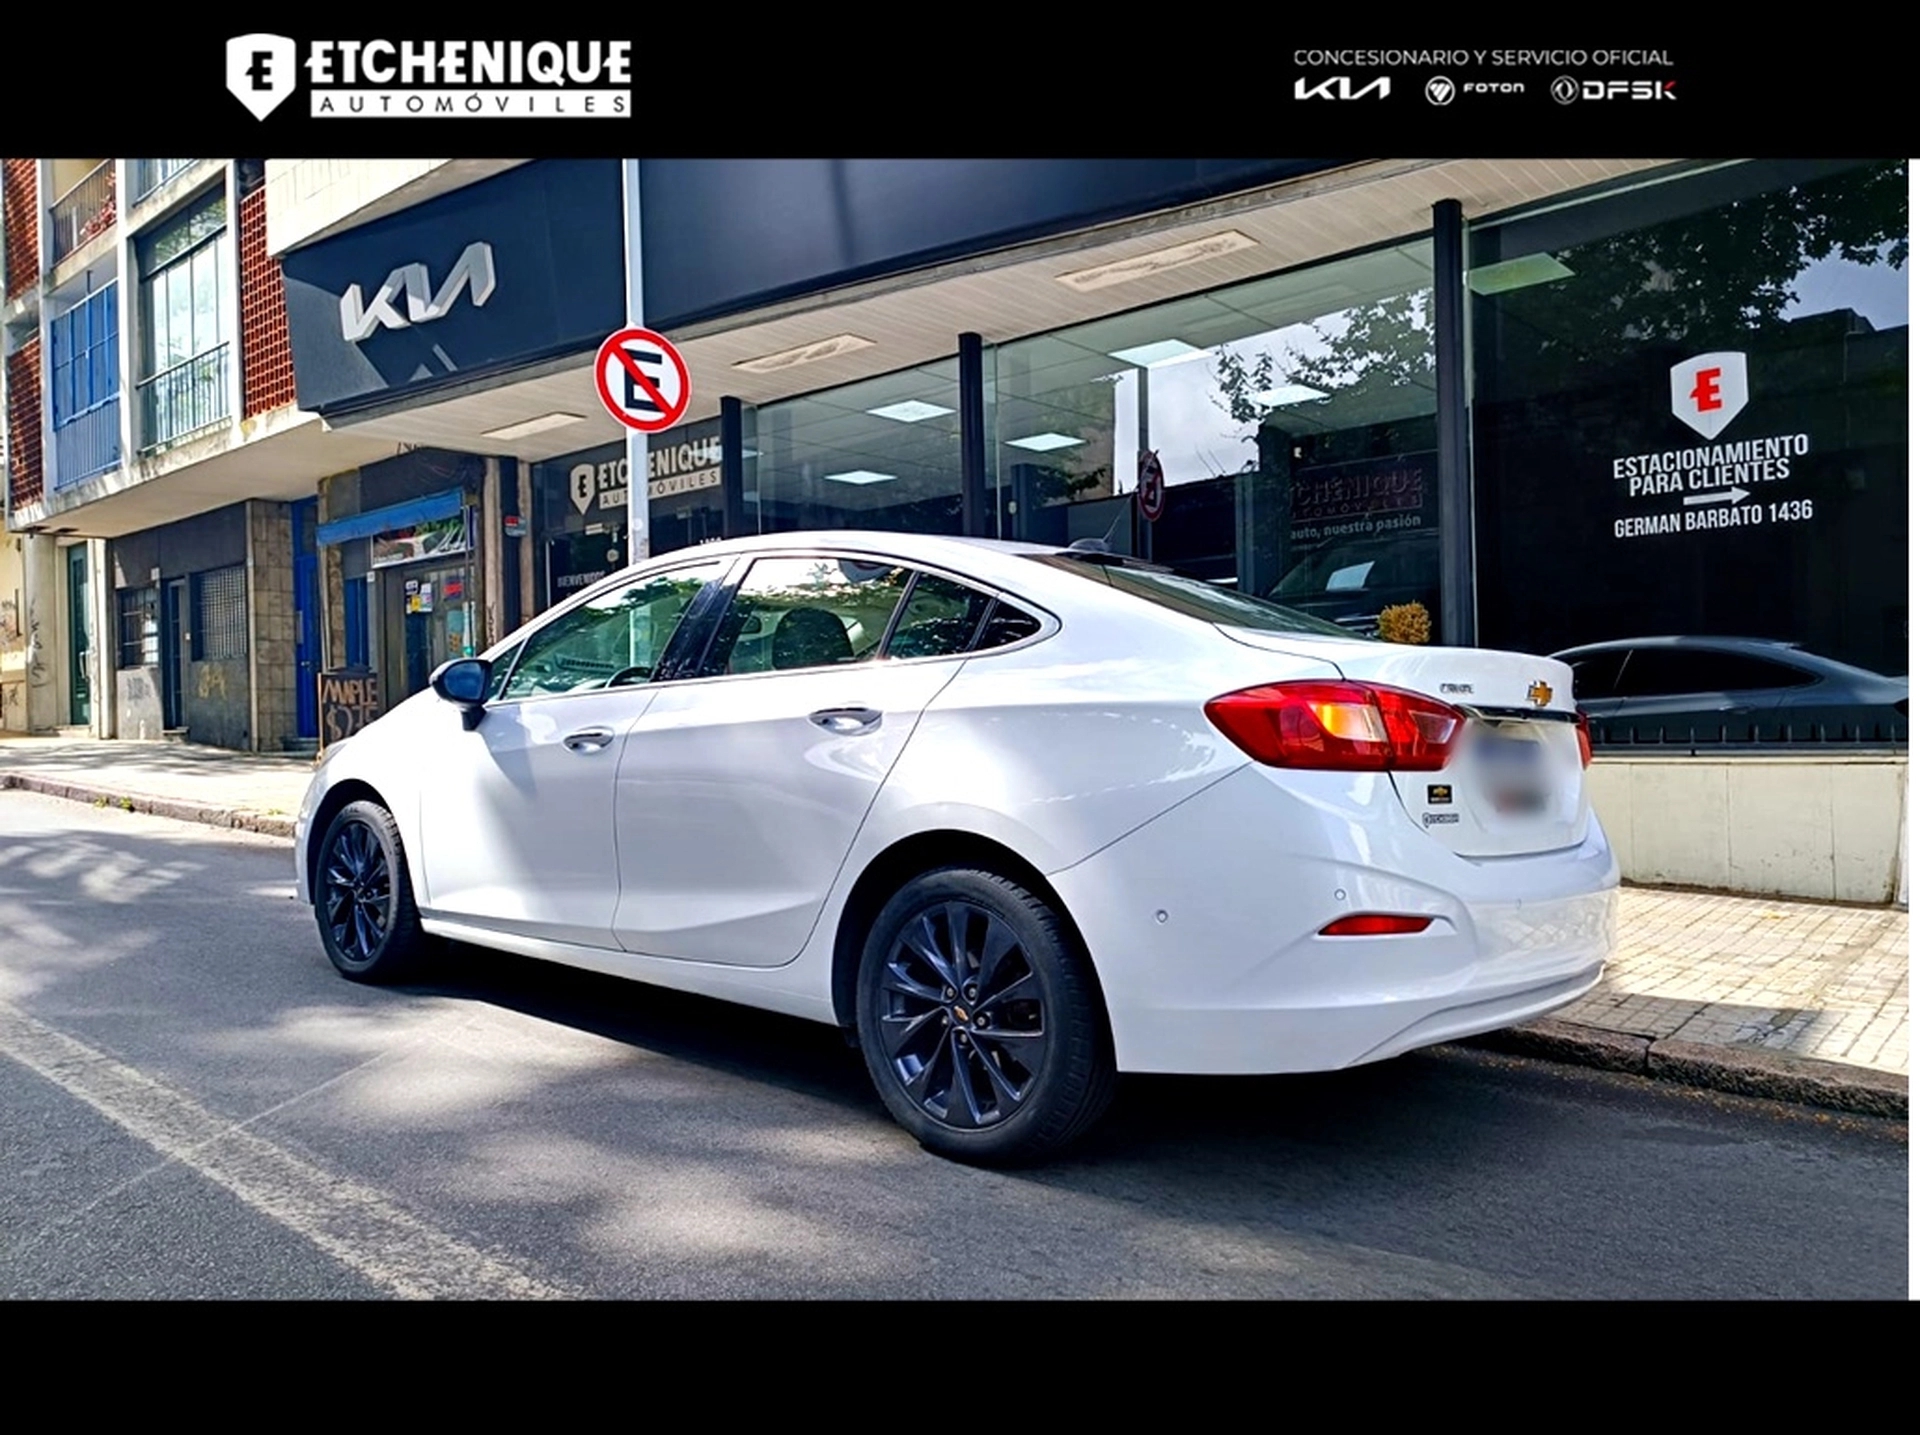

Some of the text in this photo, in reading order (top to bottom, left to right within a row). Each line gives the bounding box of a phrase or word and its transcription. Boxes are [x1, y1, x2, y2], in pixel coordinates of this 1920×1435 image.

[623, 347, 664, 413] E
[597, 436, 722, 489] ETCENIQUE
[1613, 433, 1809, 479] ESTACIONAMIENTO
[1629, 457, 1790, 497] PARA CLIENTES
[1323, 520, 1373, 536] nuestra
[1375, 513, 1421, 536] pasión
[1614, 499, 1813, 538] GERMAN BARBATO 1436
